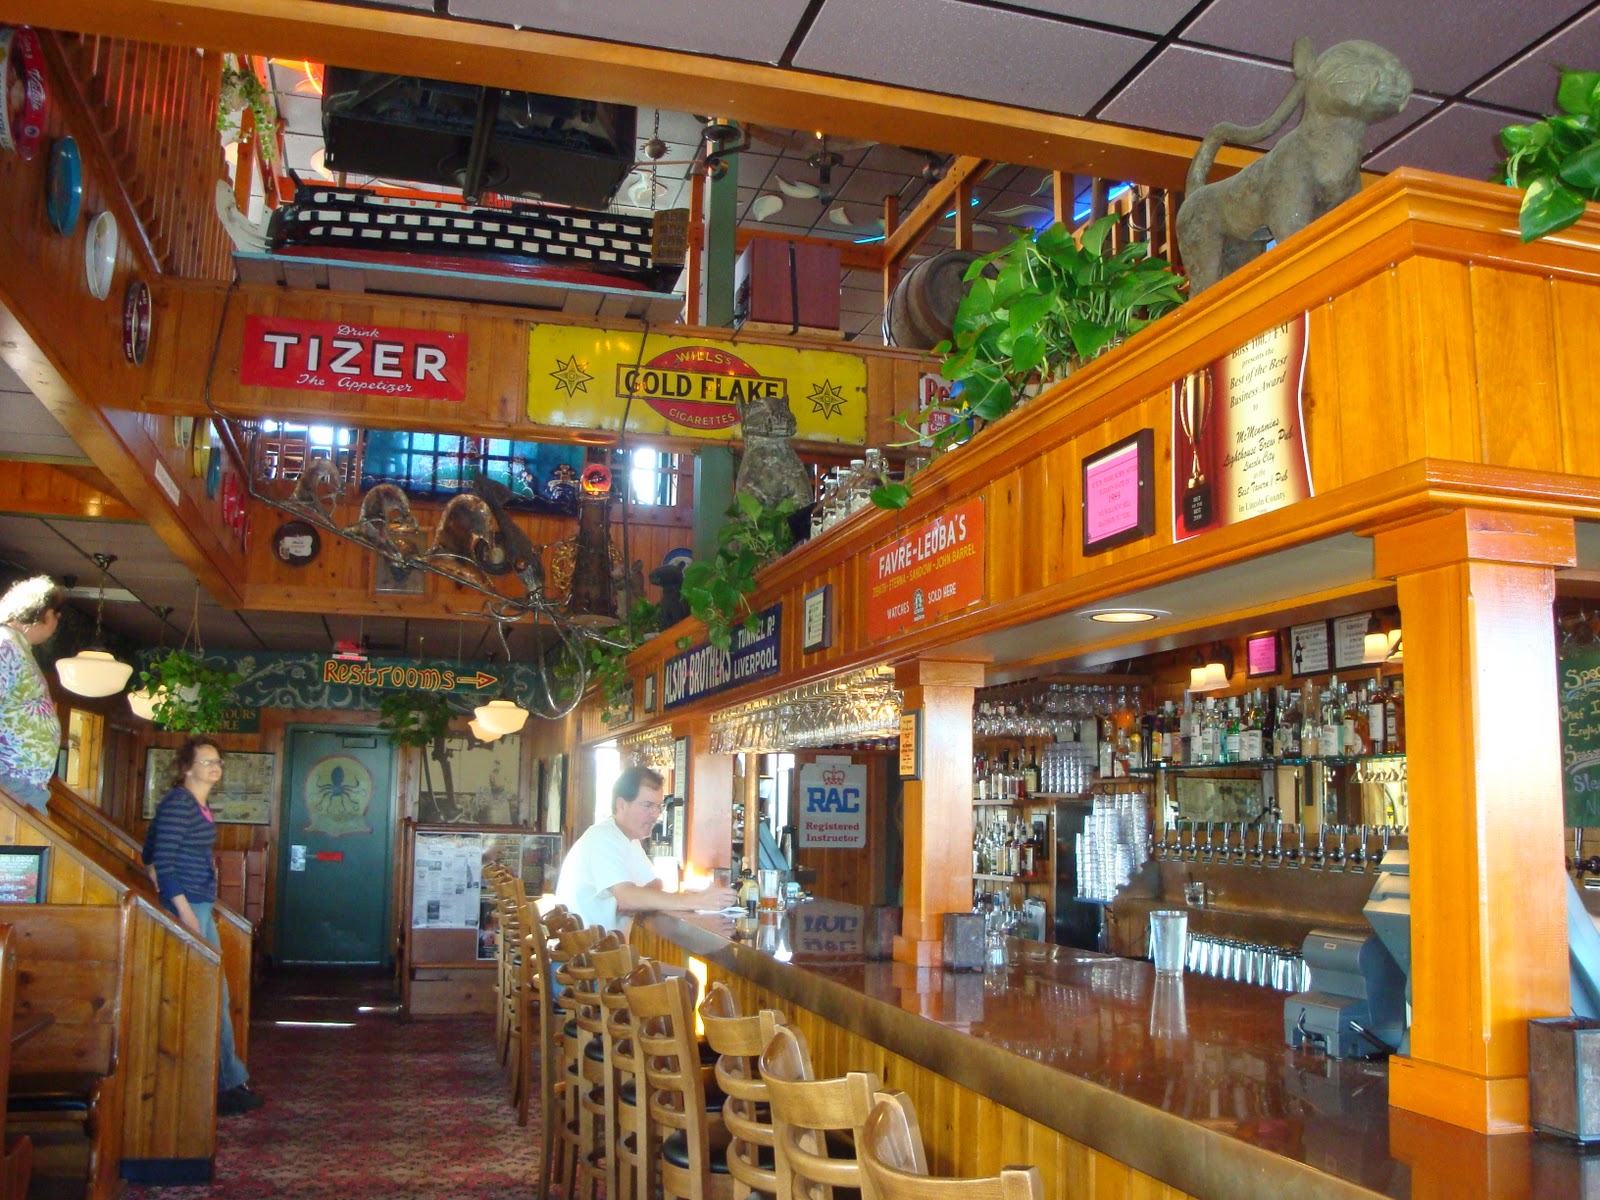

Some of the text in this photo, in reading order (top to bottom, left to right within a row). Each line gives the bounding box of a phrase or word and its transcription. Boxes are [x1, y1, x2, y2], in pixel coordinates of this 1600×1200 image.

[337, 324, 380, 338] Drink
[264, 332, 447, 382] TIZER
[1265, 347, 1275, 357] the
[297, 374, 413, 393] The Appetizer
[1230, 355, 1289, 390] Best of the Best
[625, 371, 779, 402] GOLD FLAKE
[1230, 370, 1288, 409] Business Award
[669, 408, 735, 426] CIGARETTES
[933, 413, 947, 422] THE
[1236, 418, 1280, 444] McMenamins
[1223, 425, 1293, 469] Lighthouse Brew Pub
[1243, 451, 1276, 472] Lincoln City
[1237, 486, 1250, 498] Best
[1250, 481, 1269, 495] Tavern
[1275, 469, 1289, 482] Pub
[1238, 490, 1286, 513] in Lincoln County
[879, 514, 967, 580] FAVRE-LEUBA'S
[951, 543, 976, 561] BARREL
[928, 582, 957, 604] SOLD HERE
[886, 601, 910, 619] WATCHES
[734, 645, 778, 679] LIVERPOOL
[323, 659, 456, 691] Restrooms
[664, 644, 732, 705] ALSOP BROTHERS
[807, 787, 860, 813] RAC
[805, 822, 860, 833] Registered
[806, 833, 859, 843] Instructor
